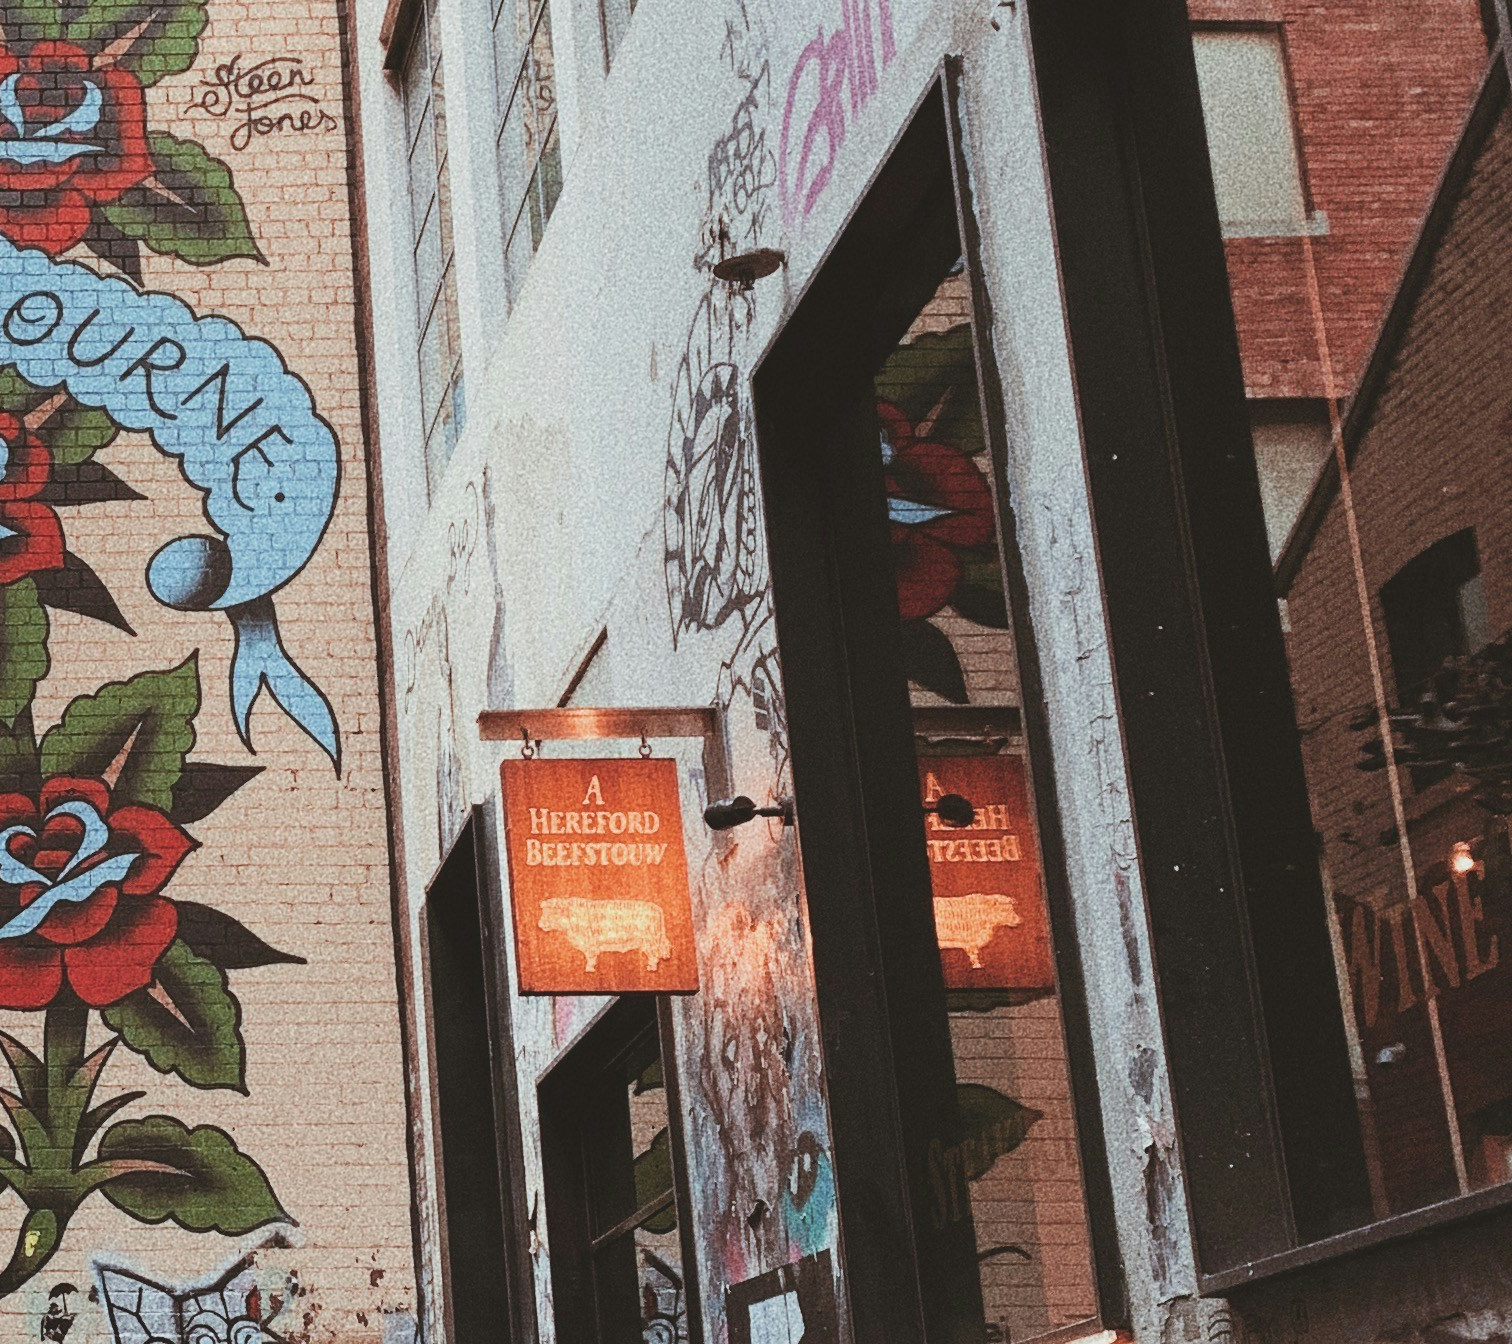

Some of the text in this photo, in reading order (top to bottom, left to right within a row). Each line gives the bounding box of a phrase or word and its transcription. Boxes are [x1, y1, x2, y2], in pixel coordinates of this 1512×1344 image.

[183, 54, 315, 117] Steen
[581, 774, 606, 805] A
[528, 807, 660, 835] HEREFORD
[525, 838, 668, 867] BEEFSTOUW
[1336, 856, 1500, 1029] WINE
